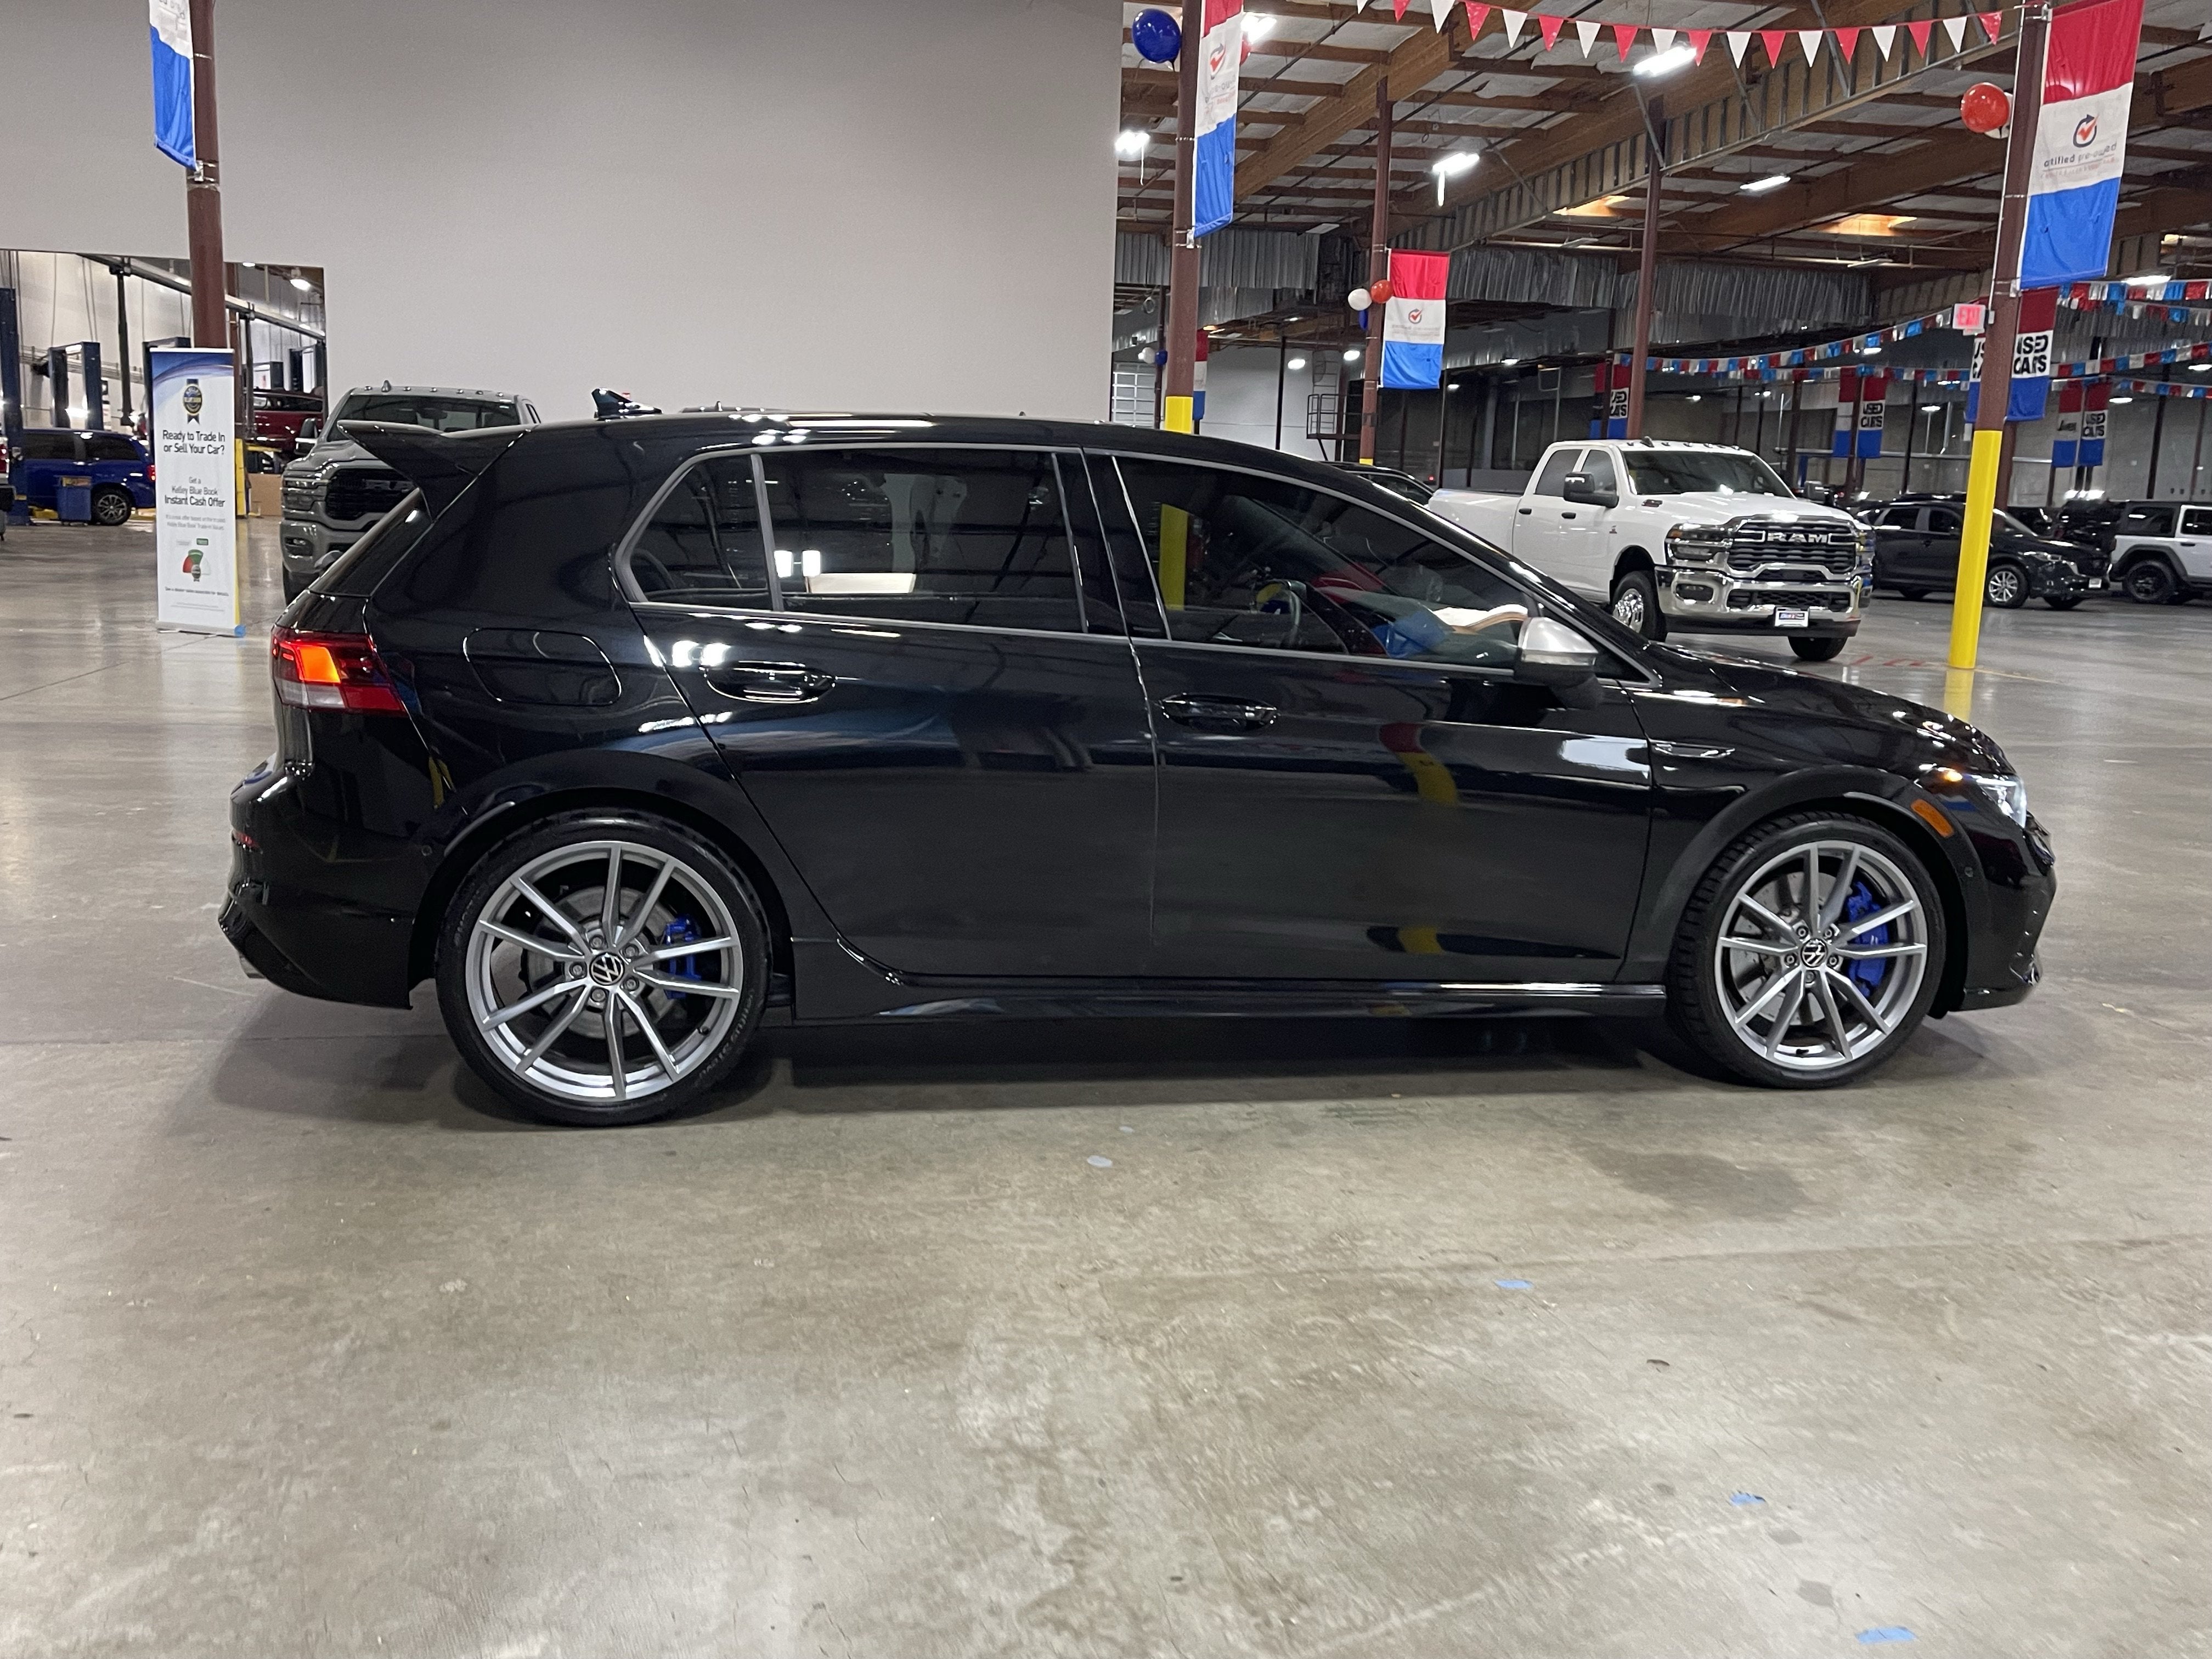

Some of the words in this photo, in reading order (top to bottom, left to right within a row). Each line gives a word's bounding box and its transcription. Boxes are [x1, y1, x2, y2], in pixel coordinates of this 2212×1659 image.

[162, 430, 185, 442] Ready
[187, 432, 194, 441] to
[196, 431, 217, 442] Trade
[218, 432, 225, 442] In
[174, 443, 188, 453] Sell
[189, 443, 205, 454] Your
[207, 444, 224, 455] Car?
[189, 486, 202, 495] Blue
[204, 487, 218, 495] Book
[165, 494, 188, 505] Instant
[190, 496, 206, 506] Cash
[208, 497, 225, 507] Offer
[1767, 533, 1827, 543] RAM
